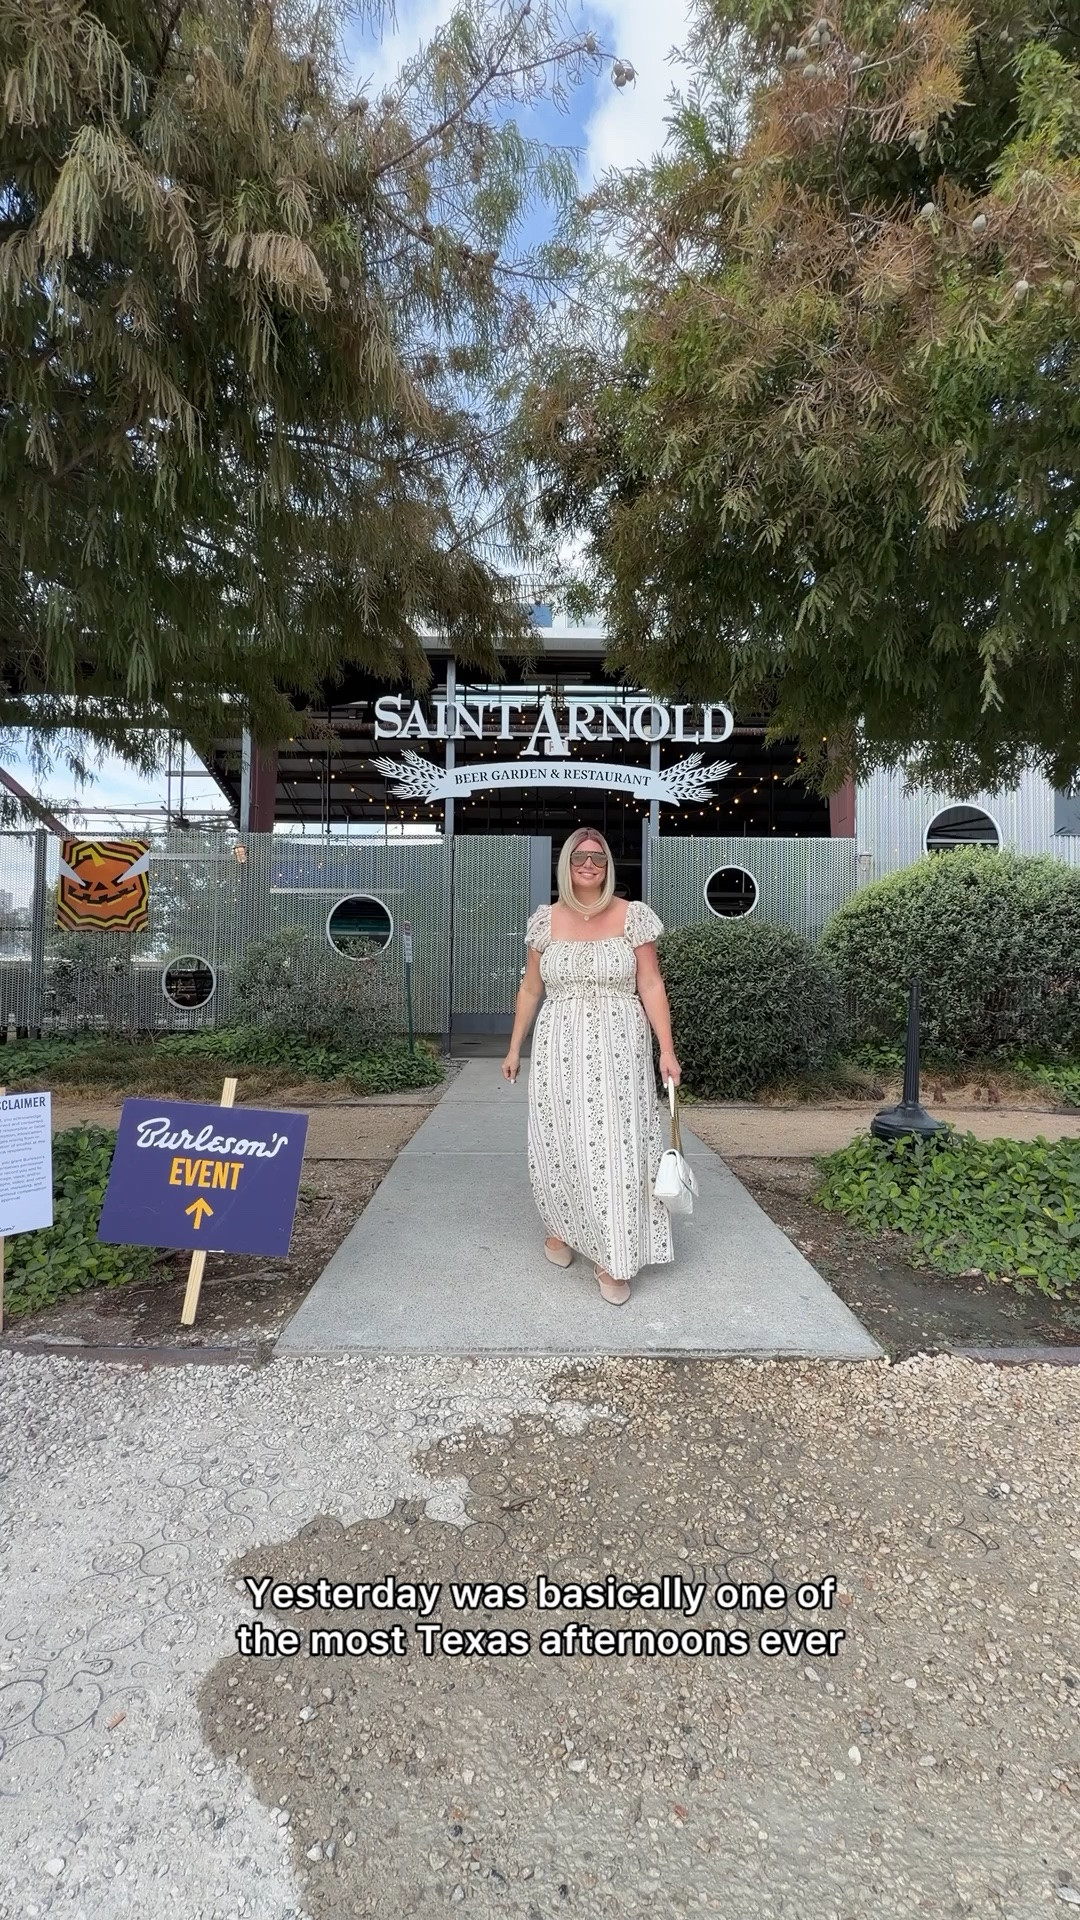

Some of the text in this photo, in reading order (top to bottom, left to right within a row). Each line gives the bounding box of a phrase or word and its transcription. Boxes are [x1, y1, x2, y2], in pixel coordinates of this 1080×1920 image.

[374, 693, 735, 757] SAINT ARNOLD
[454, 768, 652, 787] BEER GARDEN & RESTAURANT
[0, 1096, 46, 1111] CLAIMER
[136, 1117, 289, 1158] Burleson's
[169, 1157, 244, 1190] EVENT
